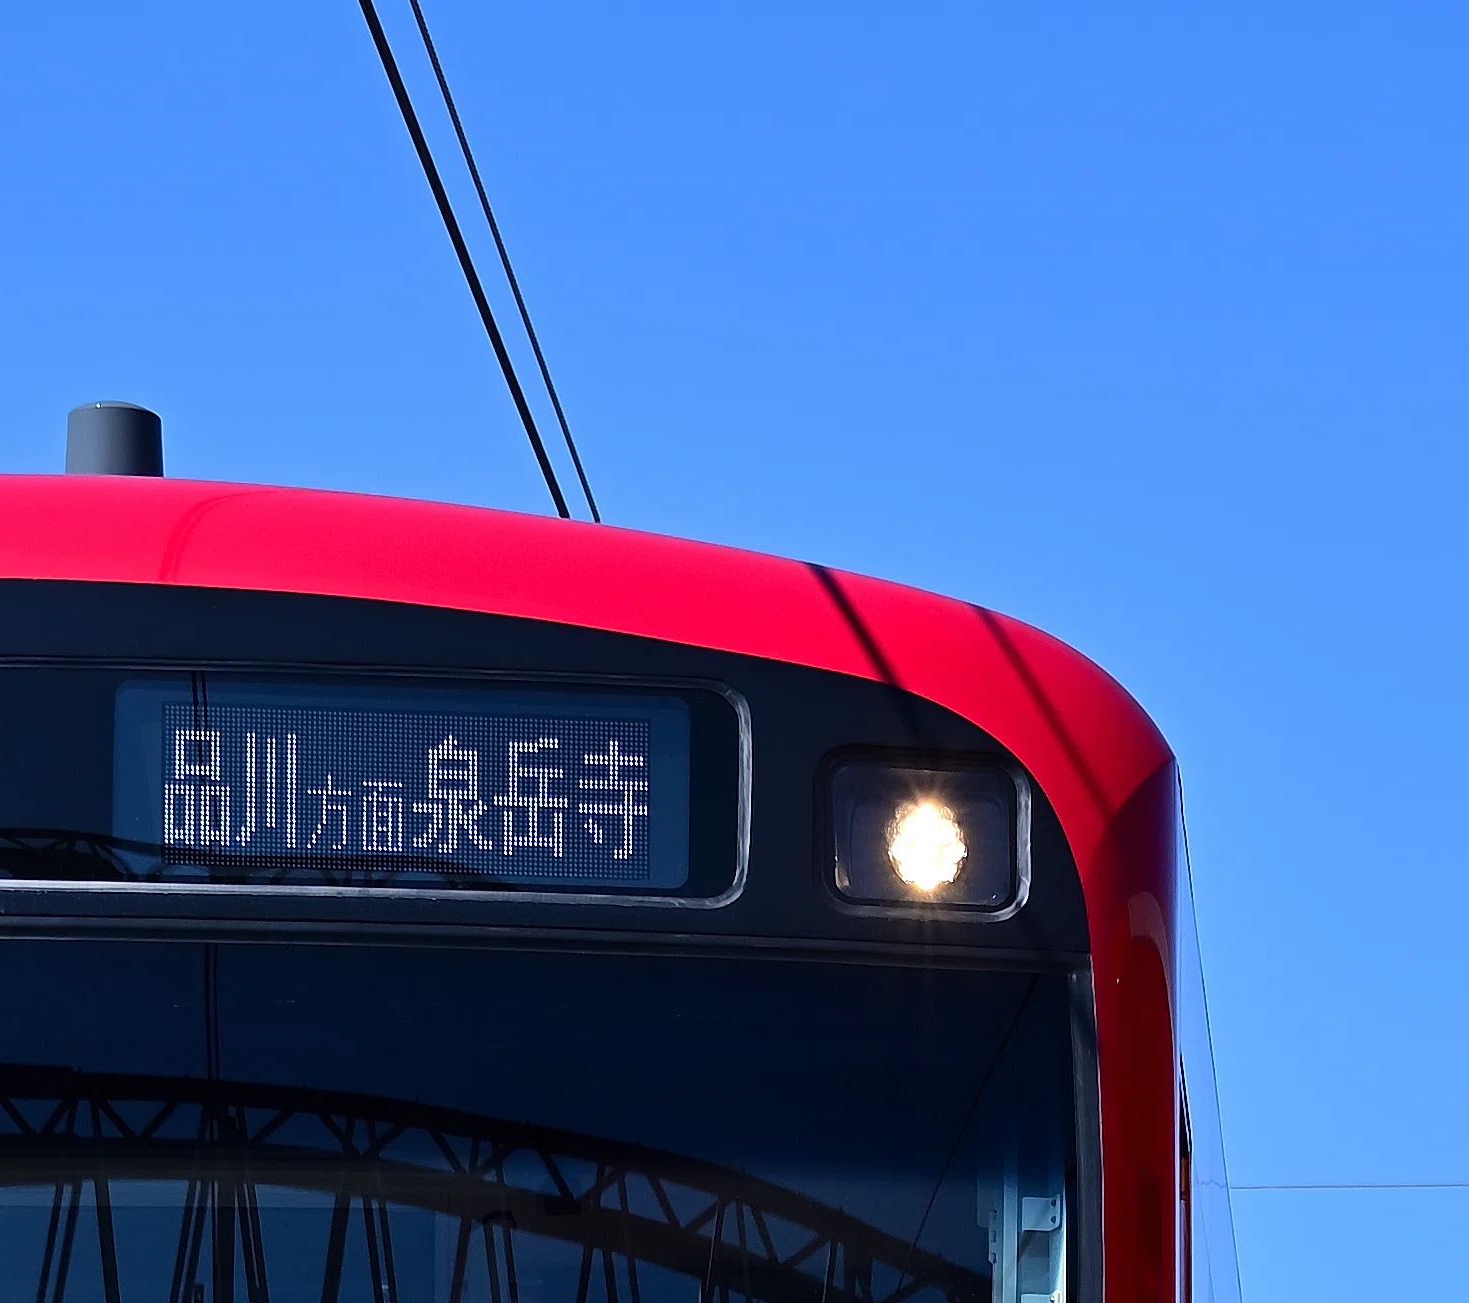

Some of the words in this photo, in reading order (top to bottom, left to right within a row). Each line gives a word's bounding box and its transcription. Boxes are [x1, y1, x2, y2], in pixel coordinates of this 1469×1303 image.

[162, 727, 651, 861] 品川方面泉岳寺
